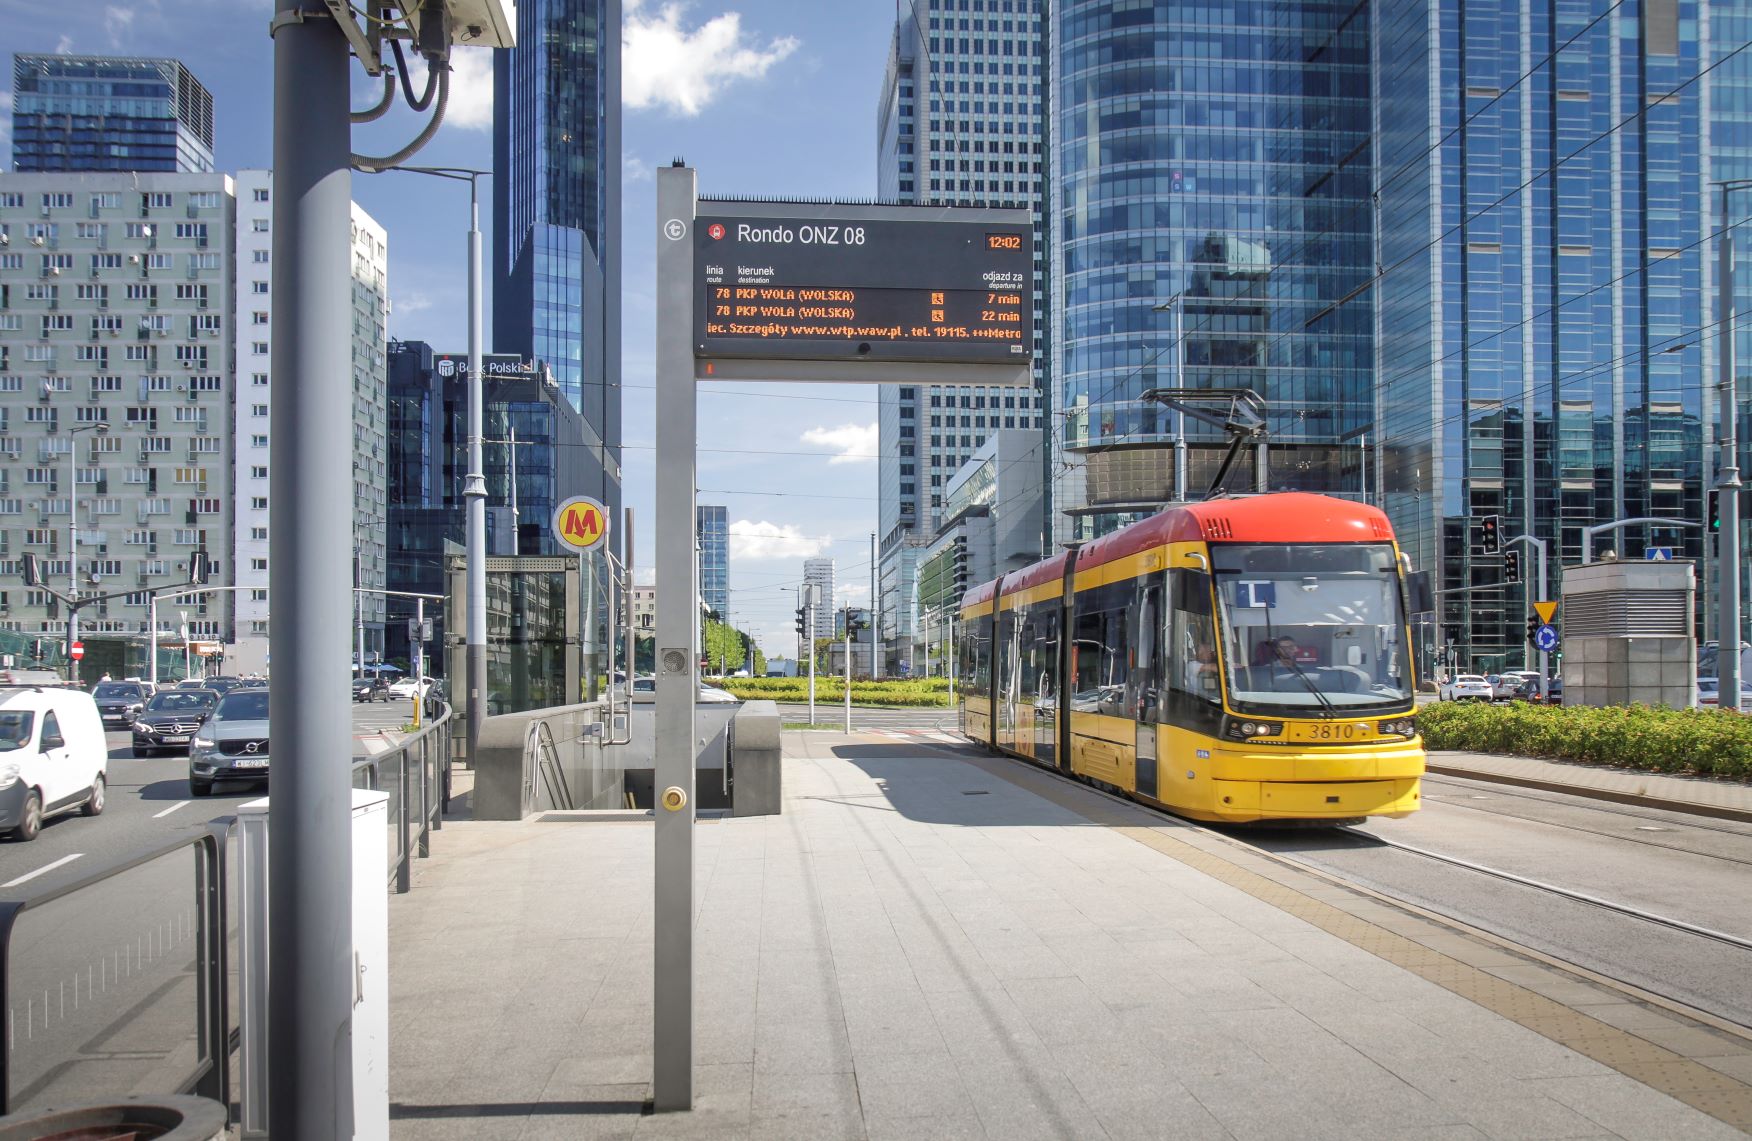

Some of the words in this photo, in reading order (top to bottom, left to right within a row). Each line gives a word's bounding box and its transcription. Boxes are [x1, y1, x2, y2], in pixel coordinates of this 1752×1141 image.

[738, 224, 794, 243] Rondo
[799, 226, 839, 245] ONZ
[844, 227, 865, 245] 08
[989, 236, 1020, 248] 12:02
[706, 265, 724, 275] linia
[738, 265, 775, 276] kierunek
[982, 271, 1011, 283] odjazd
[1013, 273, 1023, 281] za
[738, 276, 770, 284] destination
[988, 282, 1016, 290] departure
[716, 288, 730, 299] 78
[736, 288, 757, 299] PKP
[761, 289, 795, 300] WOLA
[799, 290, 855, 303] (WOLSKA)
[988, 293, 996, 304] 7
[998, 294, 1020, 305] min
[716, 305, 730, 316] 78
[736, 305, 757, 316] PKP
[761, 306, 795, 317] WOLA
[799, 307, 855, 320] (WOLSKA)
[982, 310, 995, 321] 22
[998, 311, 1020, 322] min
[729, 322, 788, 337] Szczegóły
[791, 325, 901, 339] www.wtp.waw.pl
[911, 326, 931, 337] tel.
[934, 327, 970, 338] 19115.
[490, 362, 520, 374] Polski
[565, 509, 598, 539] M
[1308, 724, 1353, 739] 3810
